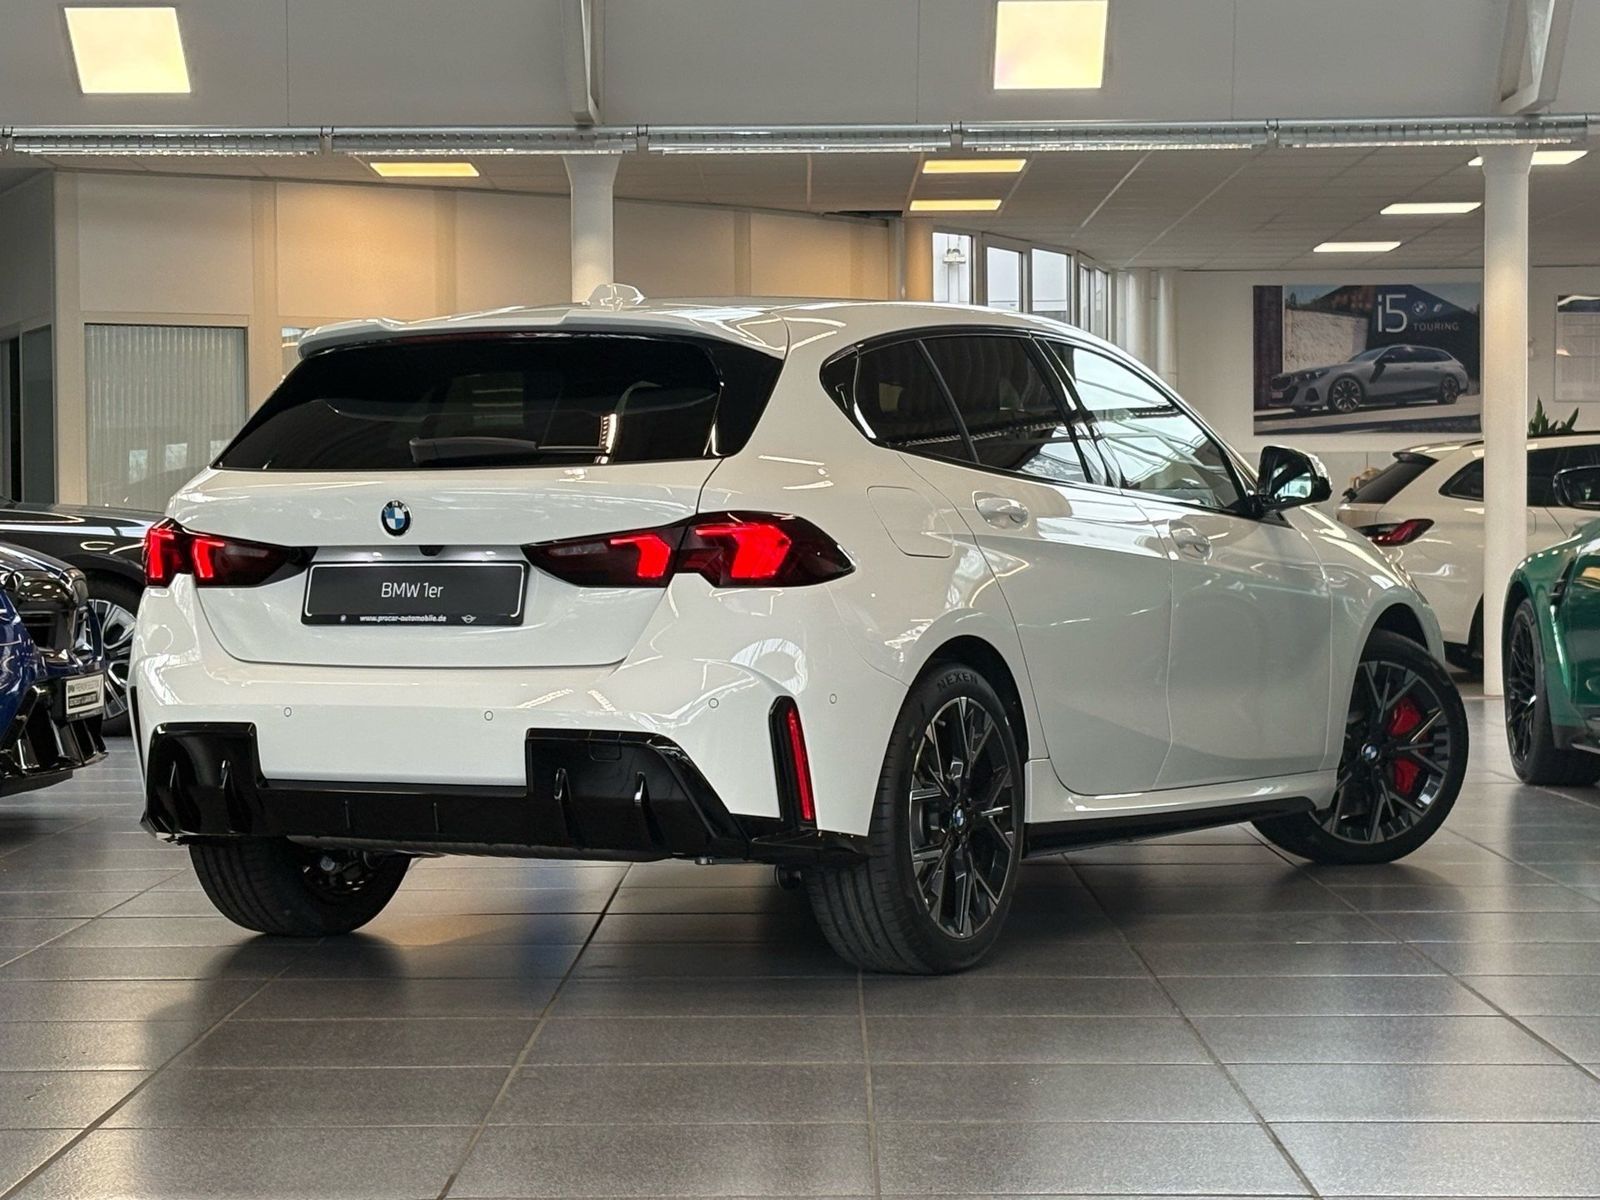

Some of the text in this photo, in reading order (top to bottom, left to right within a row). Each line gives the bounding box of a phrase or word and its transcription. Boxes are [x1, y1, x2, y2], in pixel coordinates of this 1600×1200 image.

[1377, 294, 1408, 333] i5
[1413, 322, 1460, 331] TOURING
[381, 582, 444, 598] BMW 1er
[360, 614, 447, 623] www.procar-automobile.de
[936, 672, 979, 691] NEXEN
